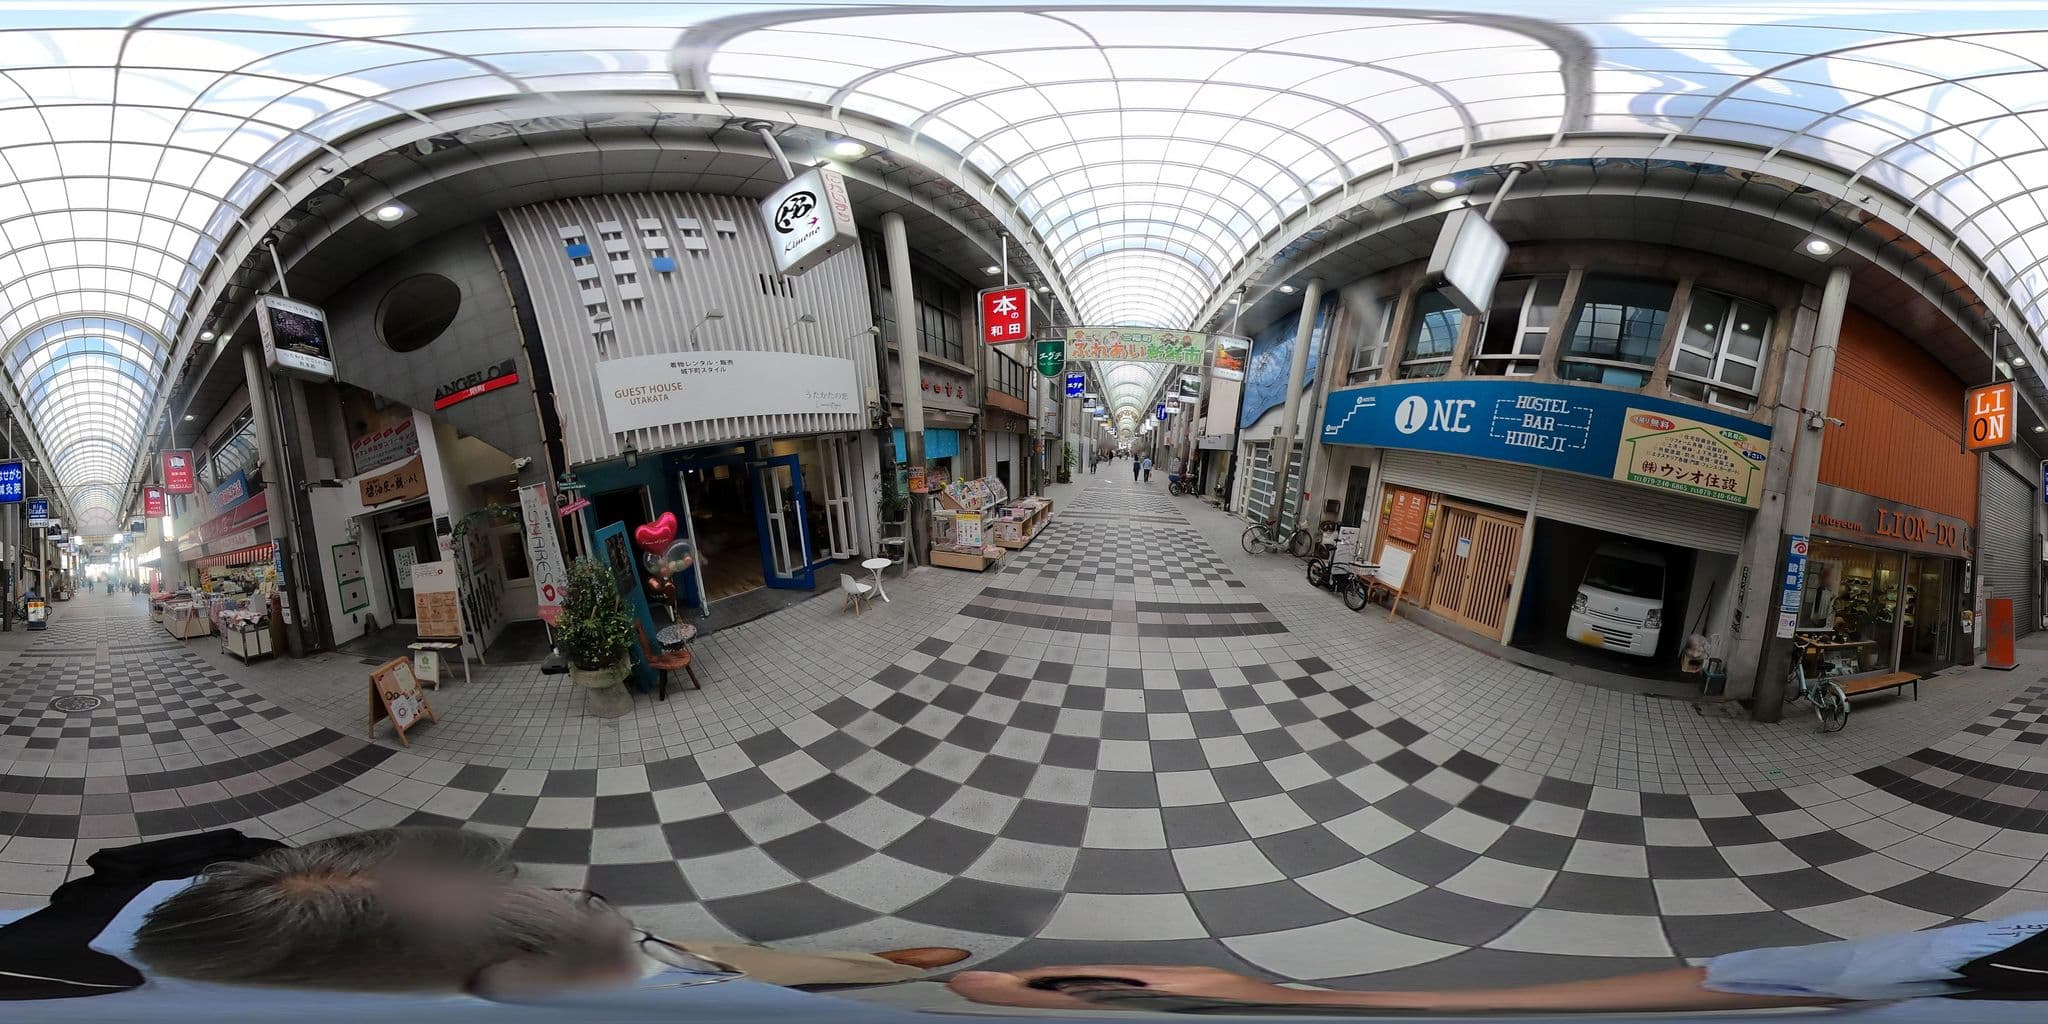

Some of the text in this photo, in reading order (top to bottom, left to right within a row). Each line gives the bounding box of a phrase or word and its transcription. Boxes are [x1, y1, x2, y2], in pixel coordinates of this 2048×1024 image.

[784, 226, 821, 255] Kimono
[991, 323, 1021, 336] 和田
[681, 366, 727, 375] 城下町スタイル
[614, 382, 684, 399] GUEST HOUSE
[629, 394, 669, 406] UTAKATA
[1515, 396, 1571, 414] HOSTEL
[1522, 414, 1555, 429] BAR
[1505, 430, 1568, 452] HIMEJI
[1818, 512, 1863, 532] Museum
